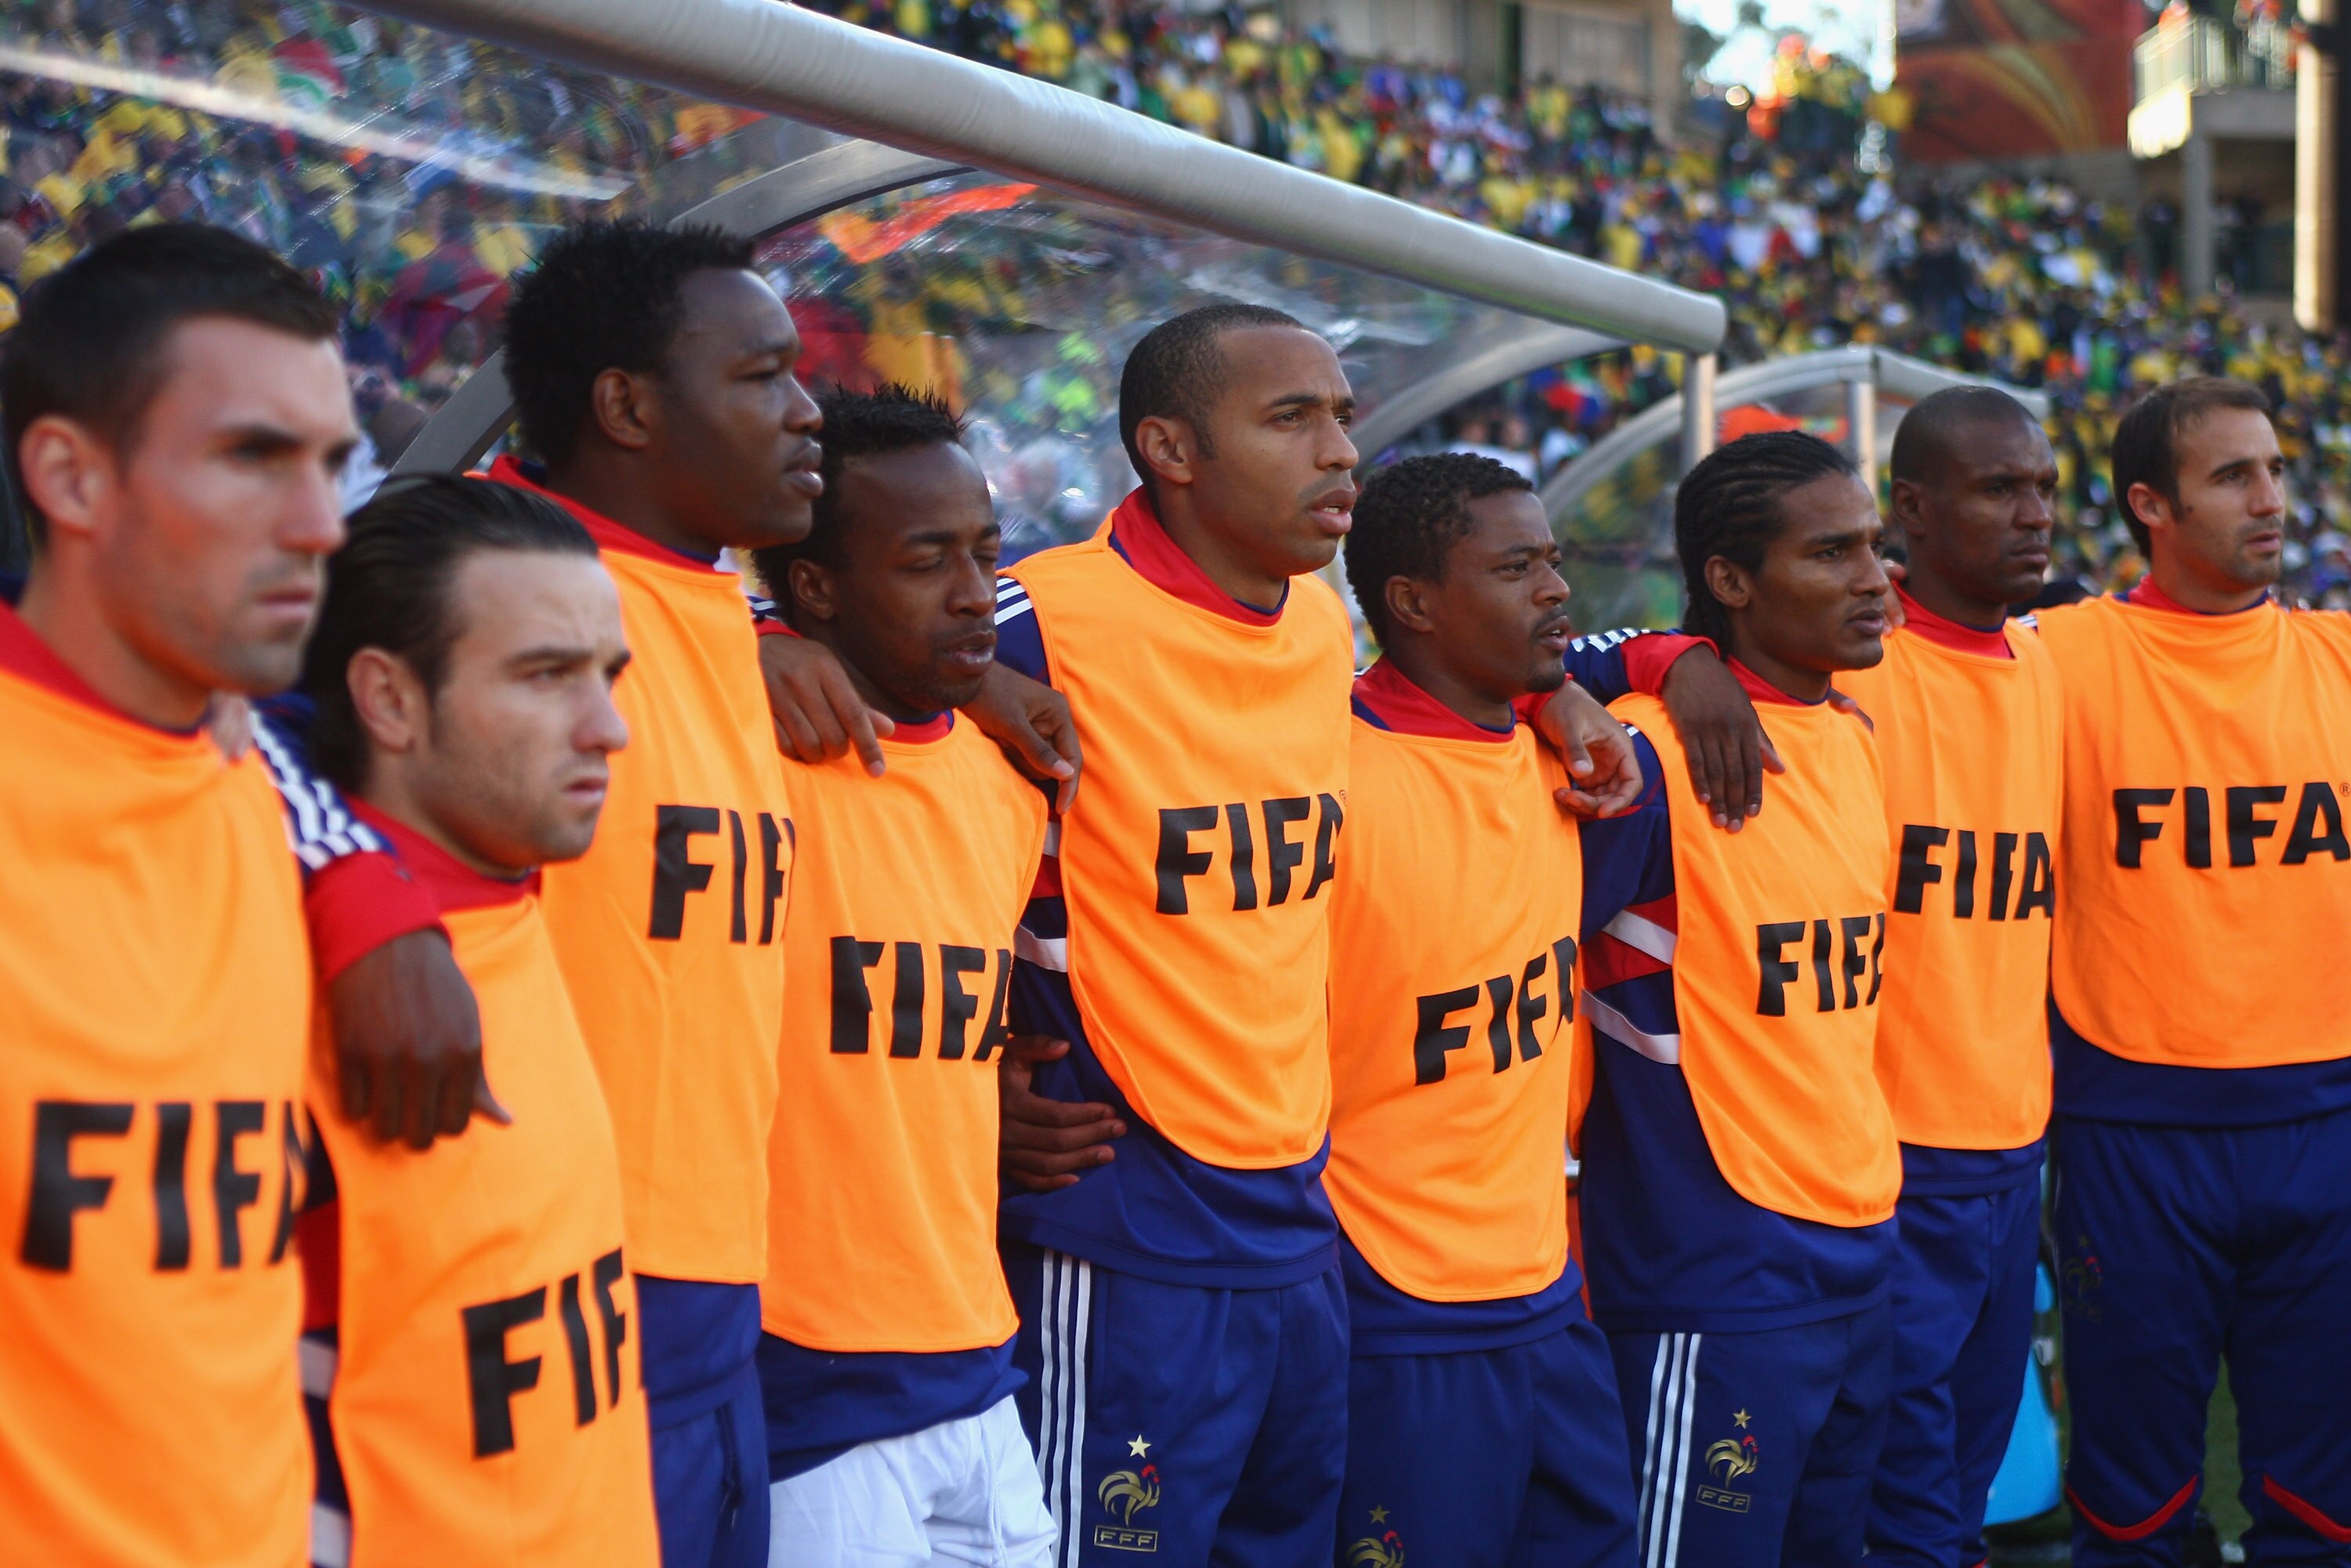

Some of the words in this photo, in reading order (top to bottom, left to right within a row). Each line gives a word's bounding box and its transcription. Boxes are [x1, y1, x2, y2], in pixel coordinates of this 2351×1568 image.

[2112, 781, 2351, 870] FIFA
[649, 804, 796, 945] FIF
[1893, 824, 2055, 922] FIFA
[1100, 1531, 1153, 1546] FFF
